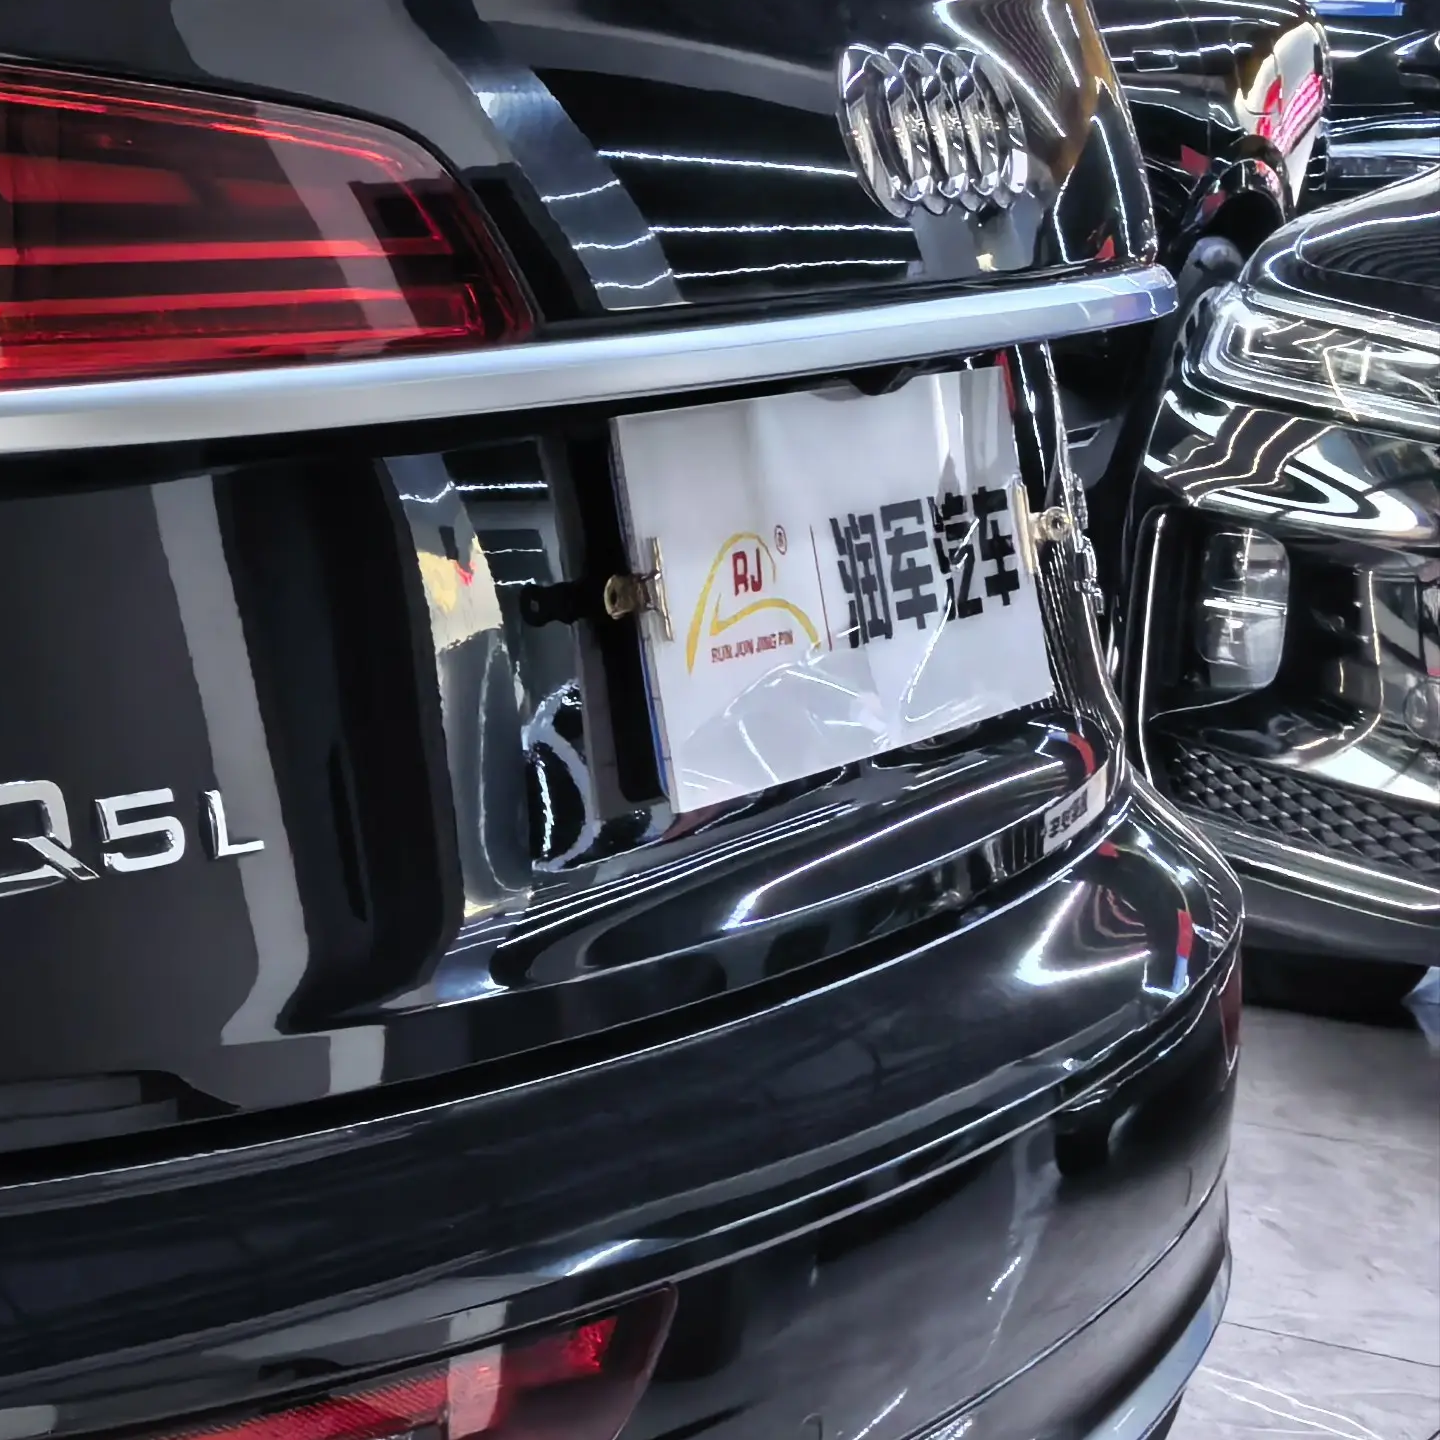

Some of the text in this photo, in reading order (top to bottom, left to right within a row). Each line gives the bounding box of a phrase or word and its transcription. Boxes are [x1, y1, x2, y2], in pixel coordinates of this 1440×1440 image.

[731, 546, 763, 597] RJ
[829, 485, 1021, 649] 润军汽车
